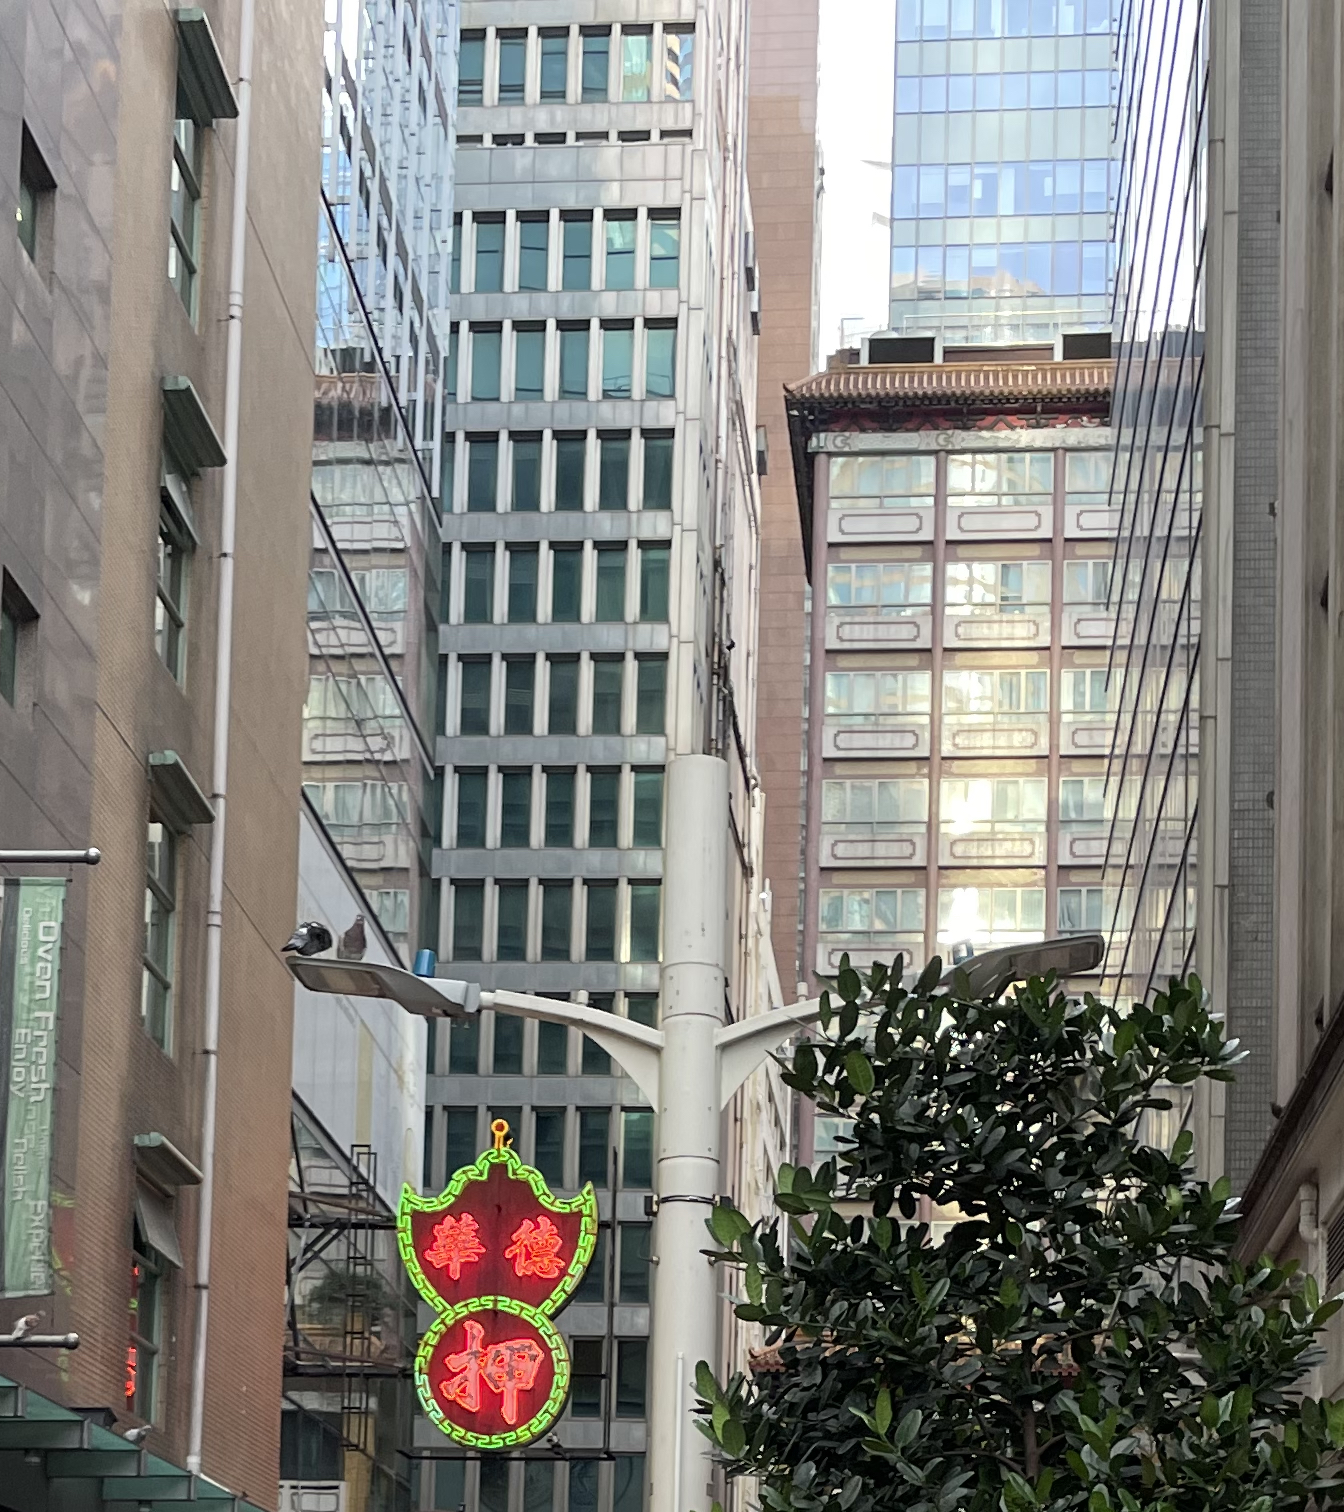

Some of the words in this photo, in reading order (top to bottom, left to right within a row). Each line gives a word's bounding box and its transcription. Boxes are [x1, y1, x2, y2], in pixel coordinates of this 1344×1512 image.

[18, 907, 33, 966] Delicious
[35, 920, 59, 1000] Oven
[9, 1028, 32, 1098] Enjoy
[30, 1010, 55, 1103] Fresh
[441, 1320, 545, 1424] 押
